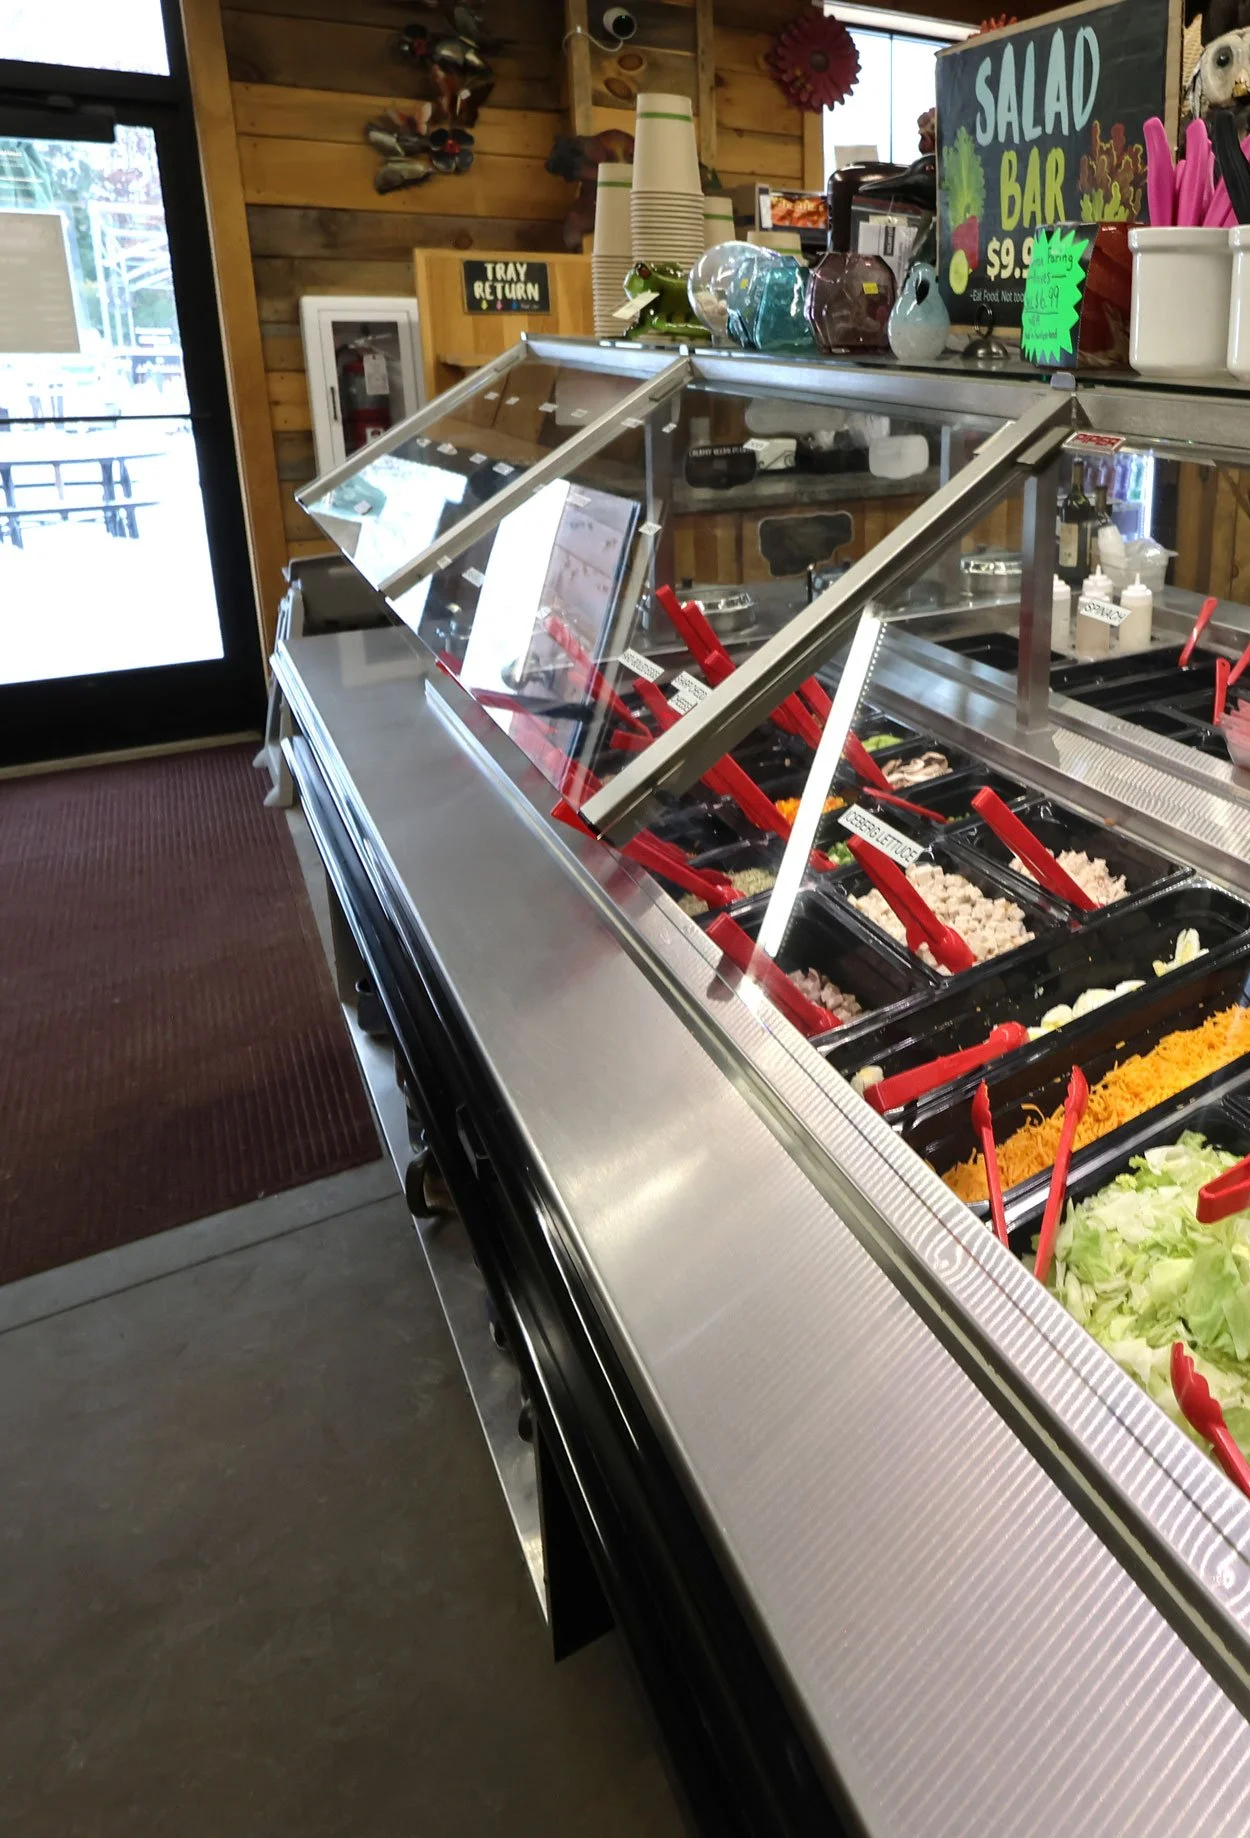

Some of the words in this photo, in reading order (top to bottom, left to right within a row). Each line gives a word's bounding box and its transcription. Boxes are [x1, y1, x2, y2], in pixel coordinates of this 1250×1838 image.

[975, 26, 1100, 147] SALAD
[1000, 146, 1066, 231] BAR
[484, 262, 528, 282] TRAY
[986, 236, 1035, 281] $9.9
[473, 280, 540, 302] RETURN
[1072, 433, 1122, 447] PIPER
[1084, 601, 1127, 621] SPINACH
[842, 810, 882, 838] ICEBERG
[876, 831, 918, 863] LETTUCE
